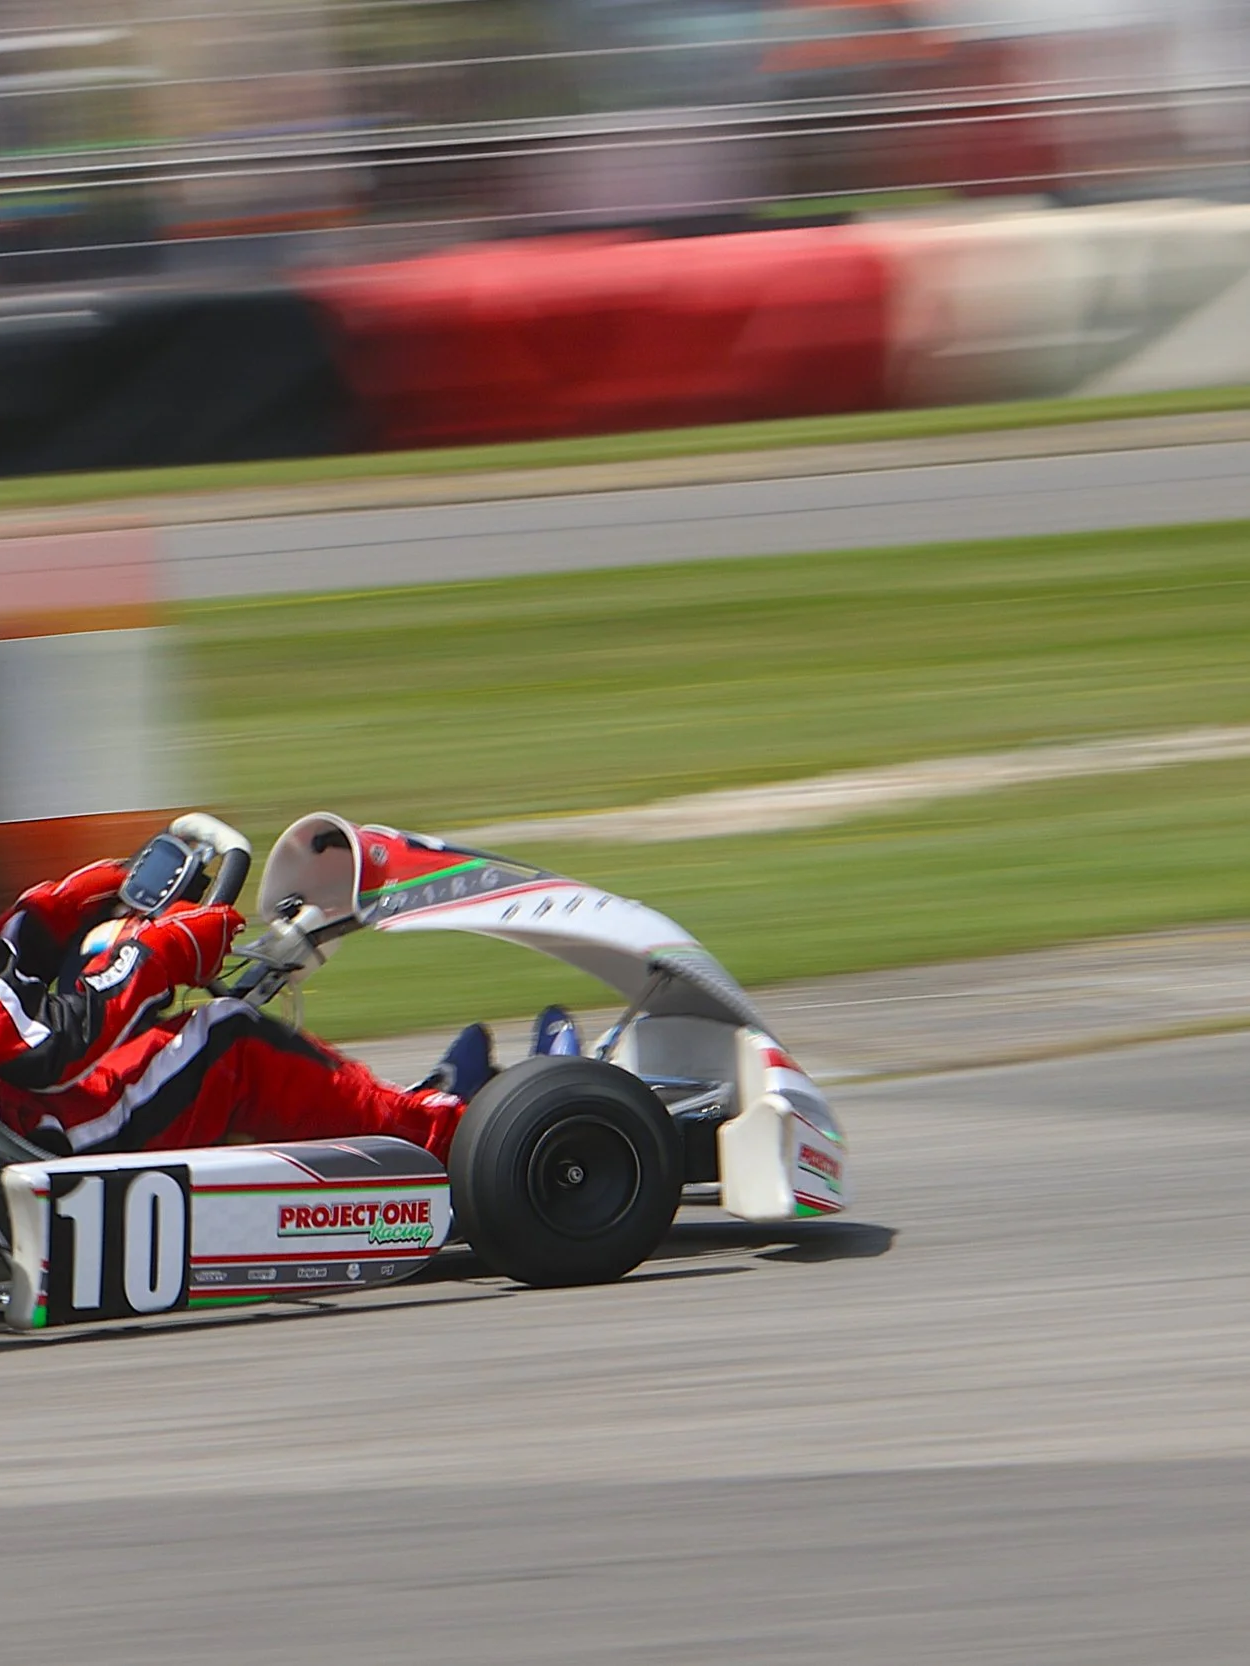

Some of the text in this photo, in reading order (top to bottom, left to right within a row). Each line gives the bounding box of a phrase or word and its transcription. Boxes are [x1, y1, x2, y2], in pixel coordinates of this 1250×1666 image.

[280, 1201, 430, 1229] PROJECT ONE
[56, 1171, 185, 1313] 10
[369, 1217, 433, 1248] Racing
